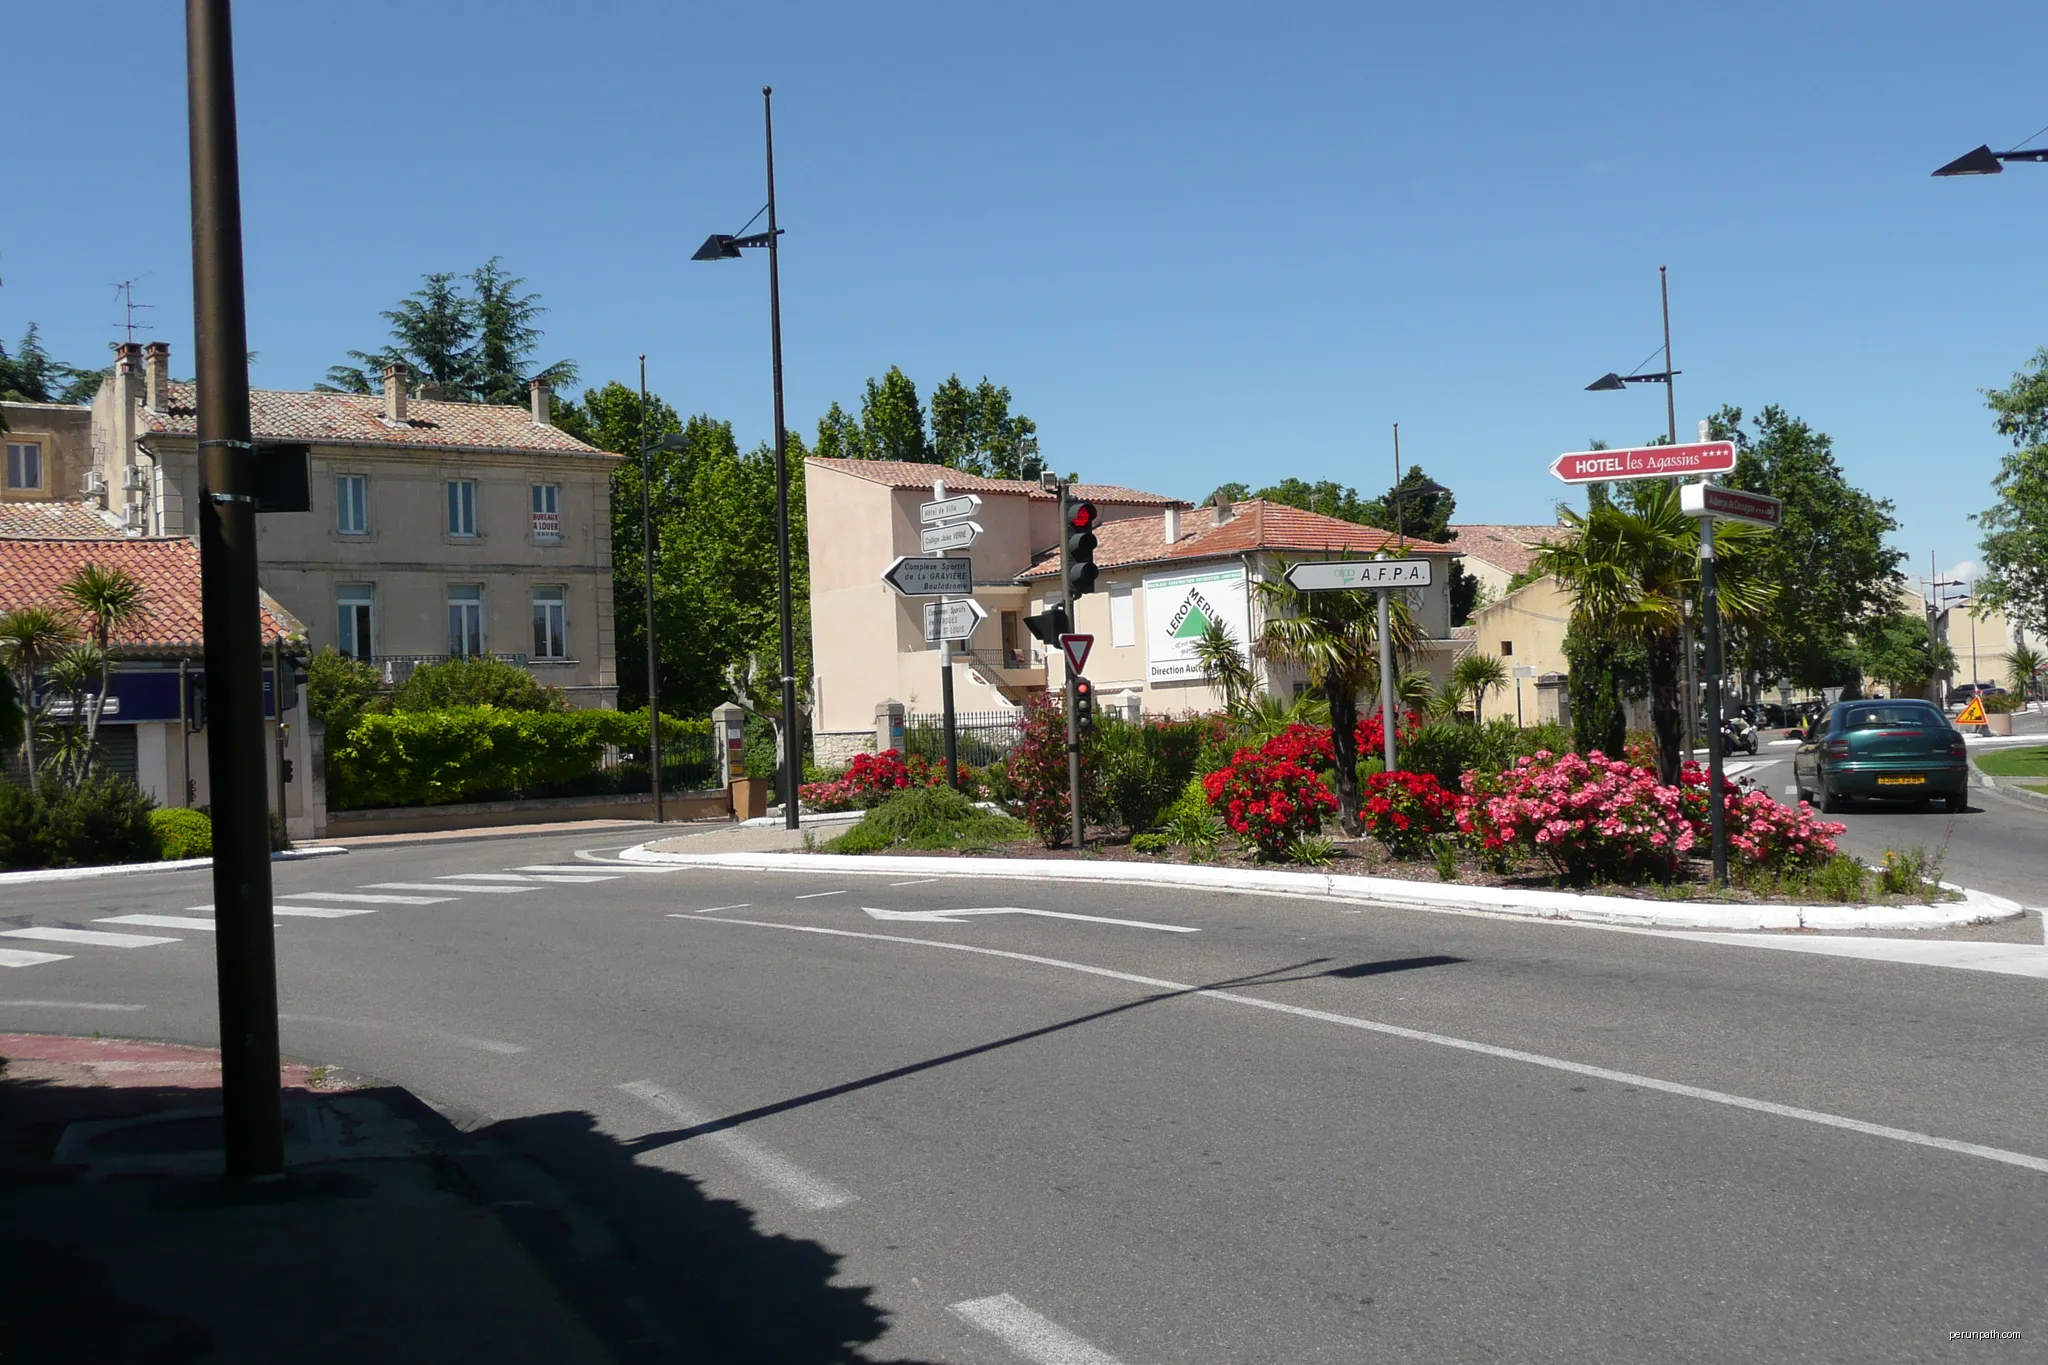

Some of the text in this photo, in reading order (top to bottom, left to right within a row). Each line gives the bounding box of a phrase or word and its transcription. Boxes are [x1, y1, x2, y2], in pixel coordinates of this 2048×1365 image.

[1575, 451, 1700, 474] HOTEL les Agassins
[539, 522, 558, 530] LOUER
[941, 533, 952, 542] Jules
[953, 530, 967, 540] VERNE
[904, 562, 967, 571] Complexe Sportif
[1360, 566, 1426, 581] A.F.P.A.
[1165, 596, 1193, 637] LEROY
[1151, 664, 1185, 676] Direction
